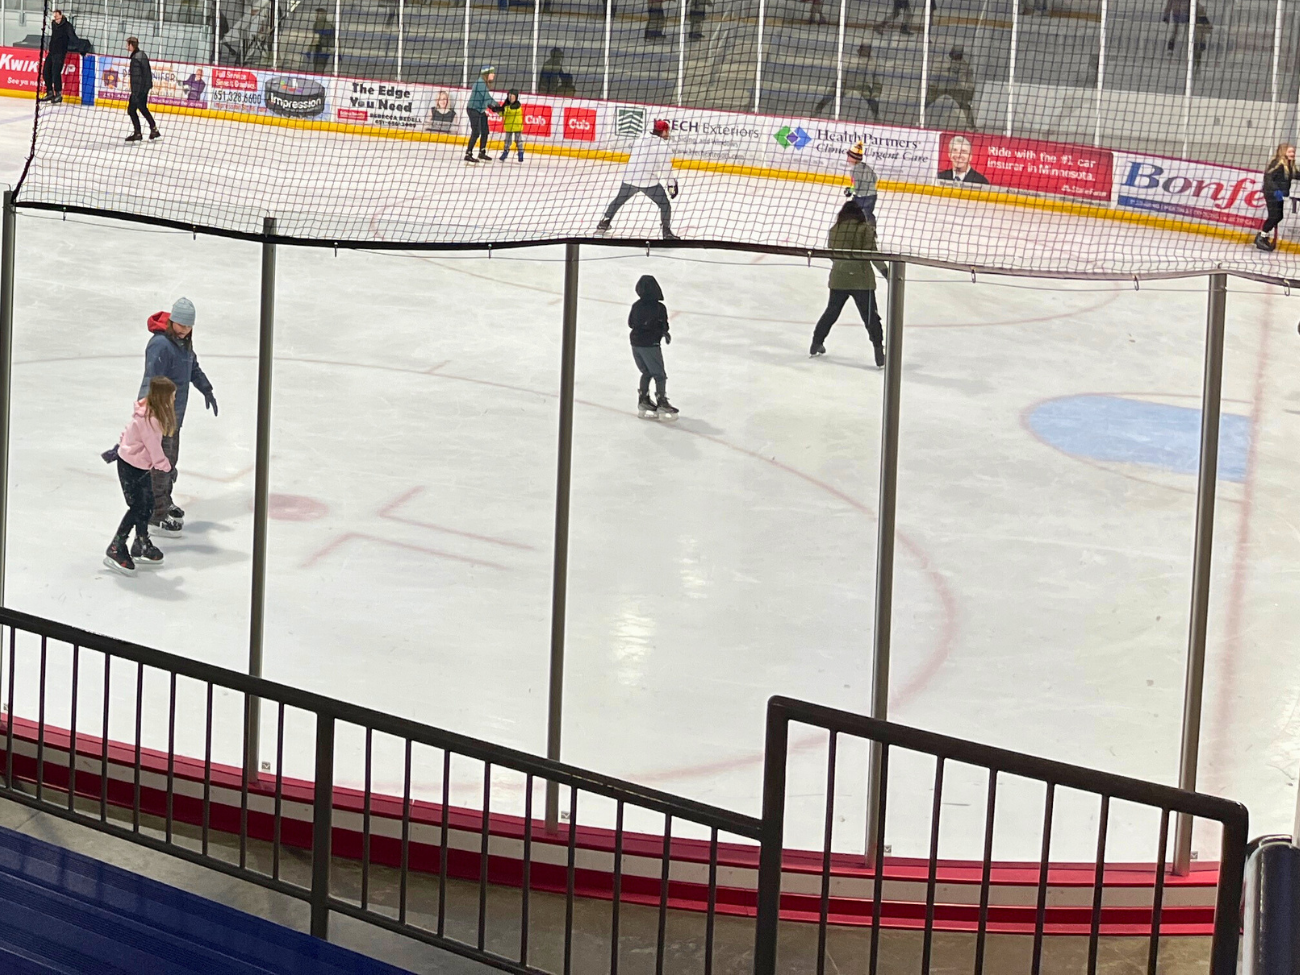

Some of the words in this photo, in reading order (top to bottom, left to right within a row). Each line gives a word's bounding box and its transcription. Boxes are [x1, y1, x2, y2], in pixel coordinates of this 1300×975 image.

[7, 77, 19, 85] See
[19, 79, 29, 87] ya
[215, 70, 225, 78] Full
[226, 71, 247, 81] Service
[352, 82, 375, 95] The
[378, 85, 411, 99] Edge
[270, 92, 322, 109] Impression
[350, 97, 375, 109] You
[378, 99, 413, 113] Need
[525, 115, 546, 126] Cub
[569, 118, 590, 130] Cub
[702, 122, 760, 139] Exteriors
[817, 129, 918, 149] HealthPartners
[864, 147, 899, 161] Urgent
[902, 151, 929, 163] Care
[987, 145, 1012, 159] Ride
[1014, 149, 1036, 160] with
[1040, 152, 1057, 164] the
[1061, 155, 1074, 166] #1
[1077, 159, 1096, 168] car
[987, 158, 1024, 172] insurer
[1027, 163, 1037, 173] in
[1038, 164, 1096, 182] Minnesota.
